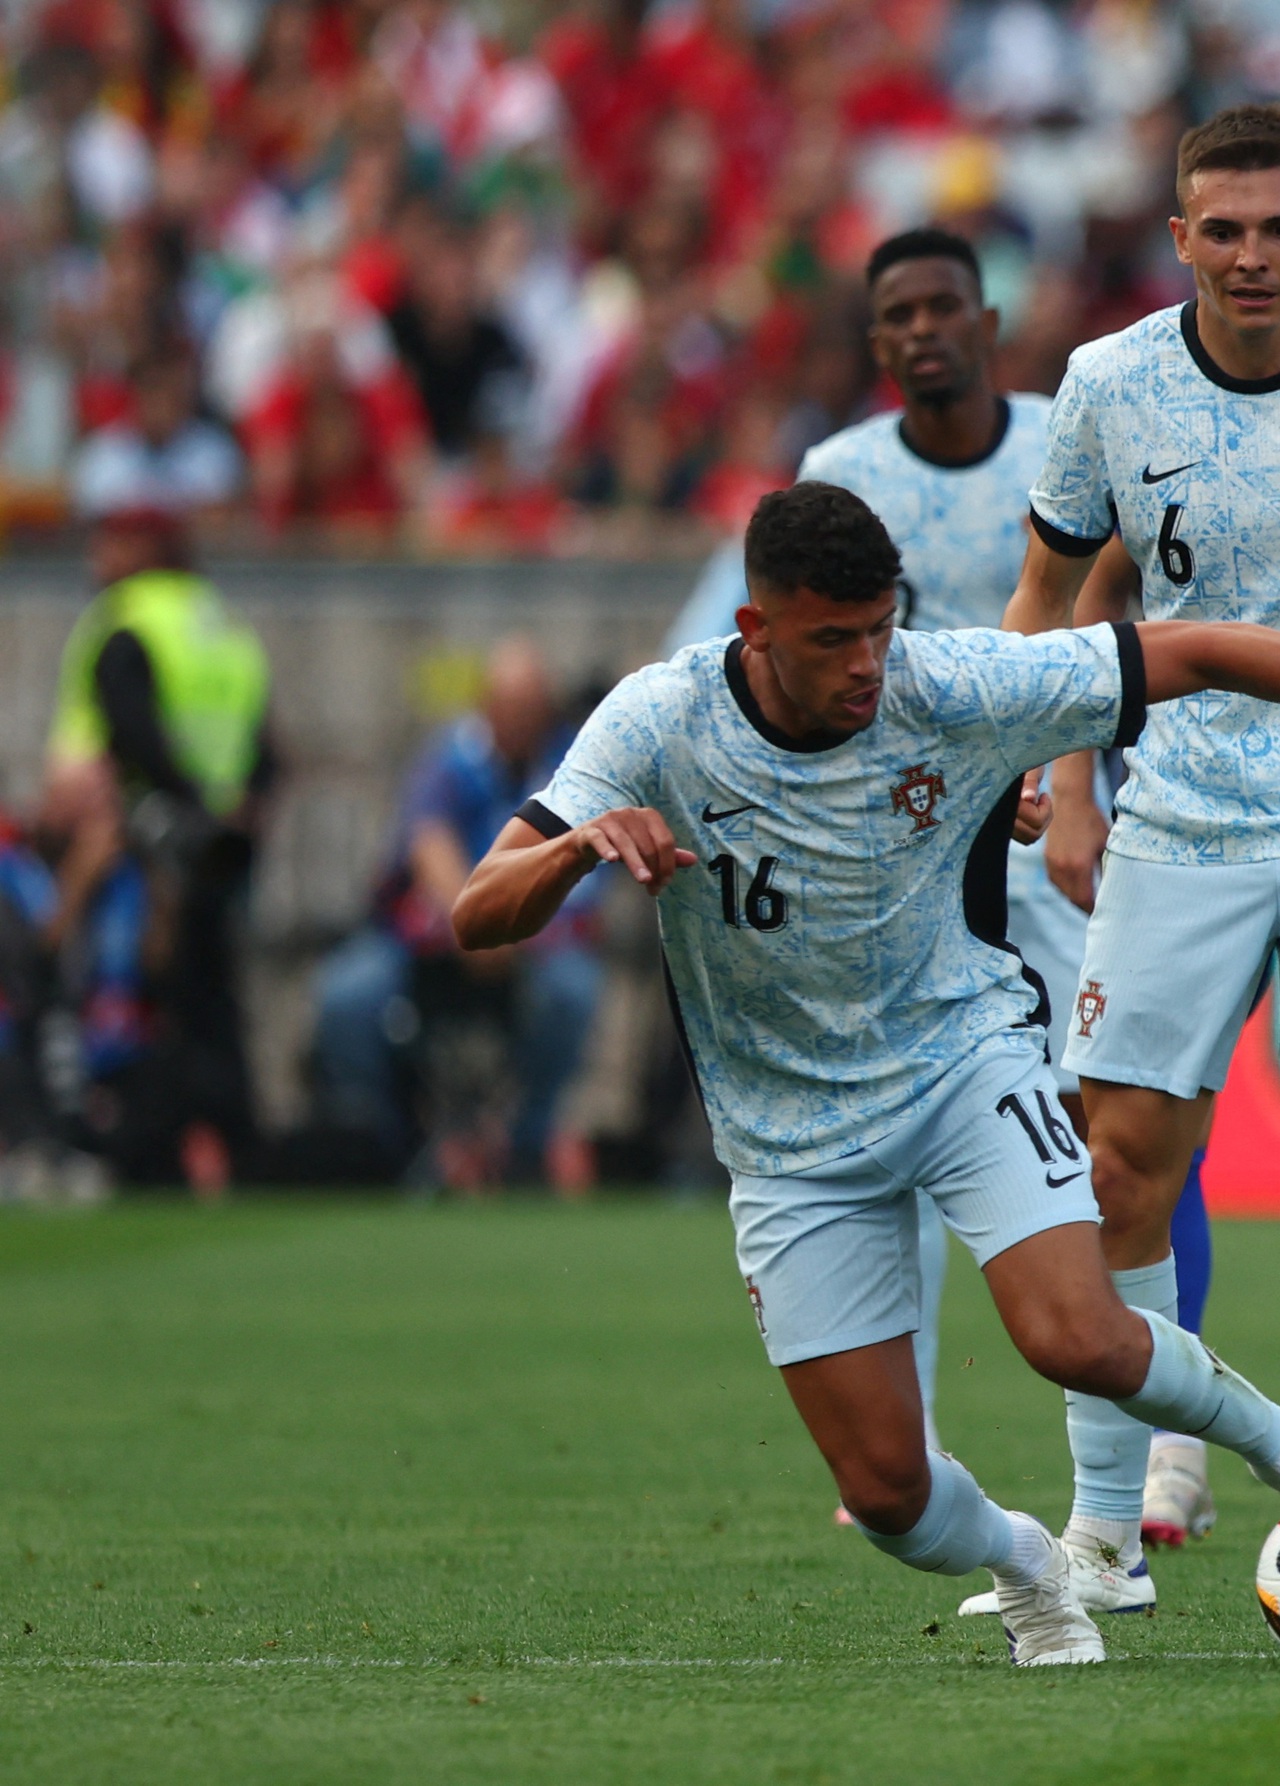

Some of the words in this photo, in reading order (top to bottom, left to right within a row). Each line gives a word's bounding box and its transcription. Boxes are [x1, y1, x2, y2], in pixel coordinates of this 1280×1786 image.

[1158, 504, 1197, 589] 6
[707, 853, 789, 934] 16
[995, 1088, 1082, 1165] 16
